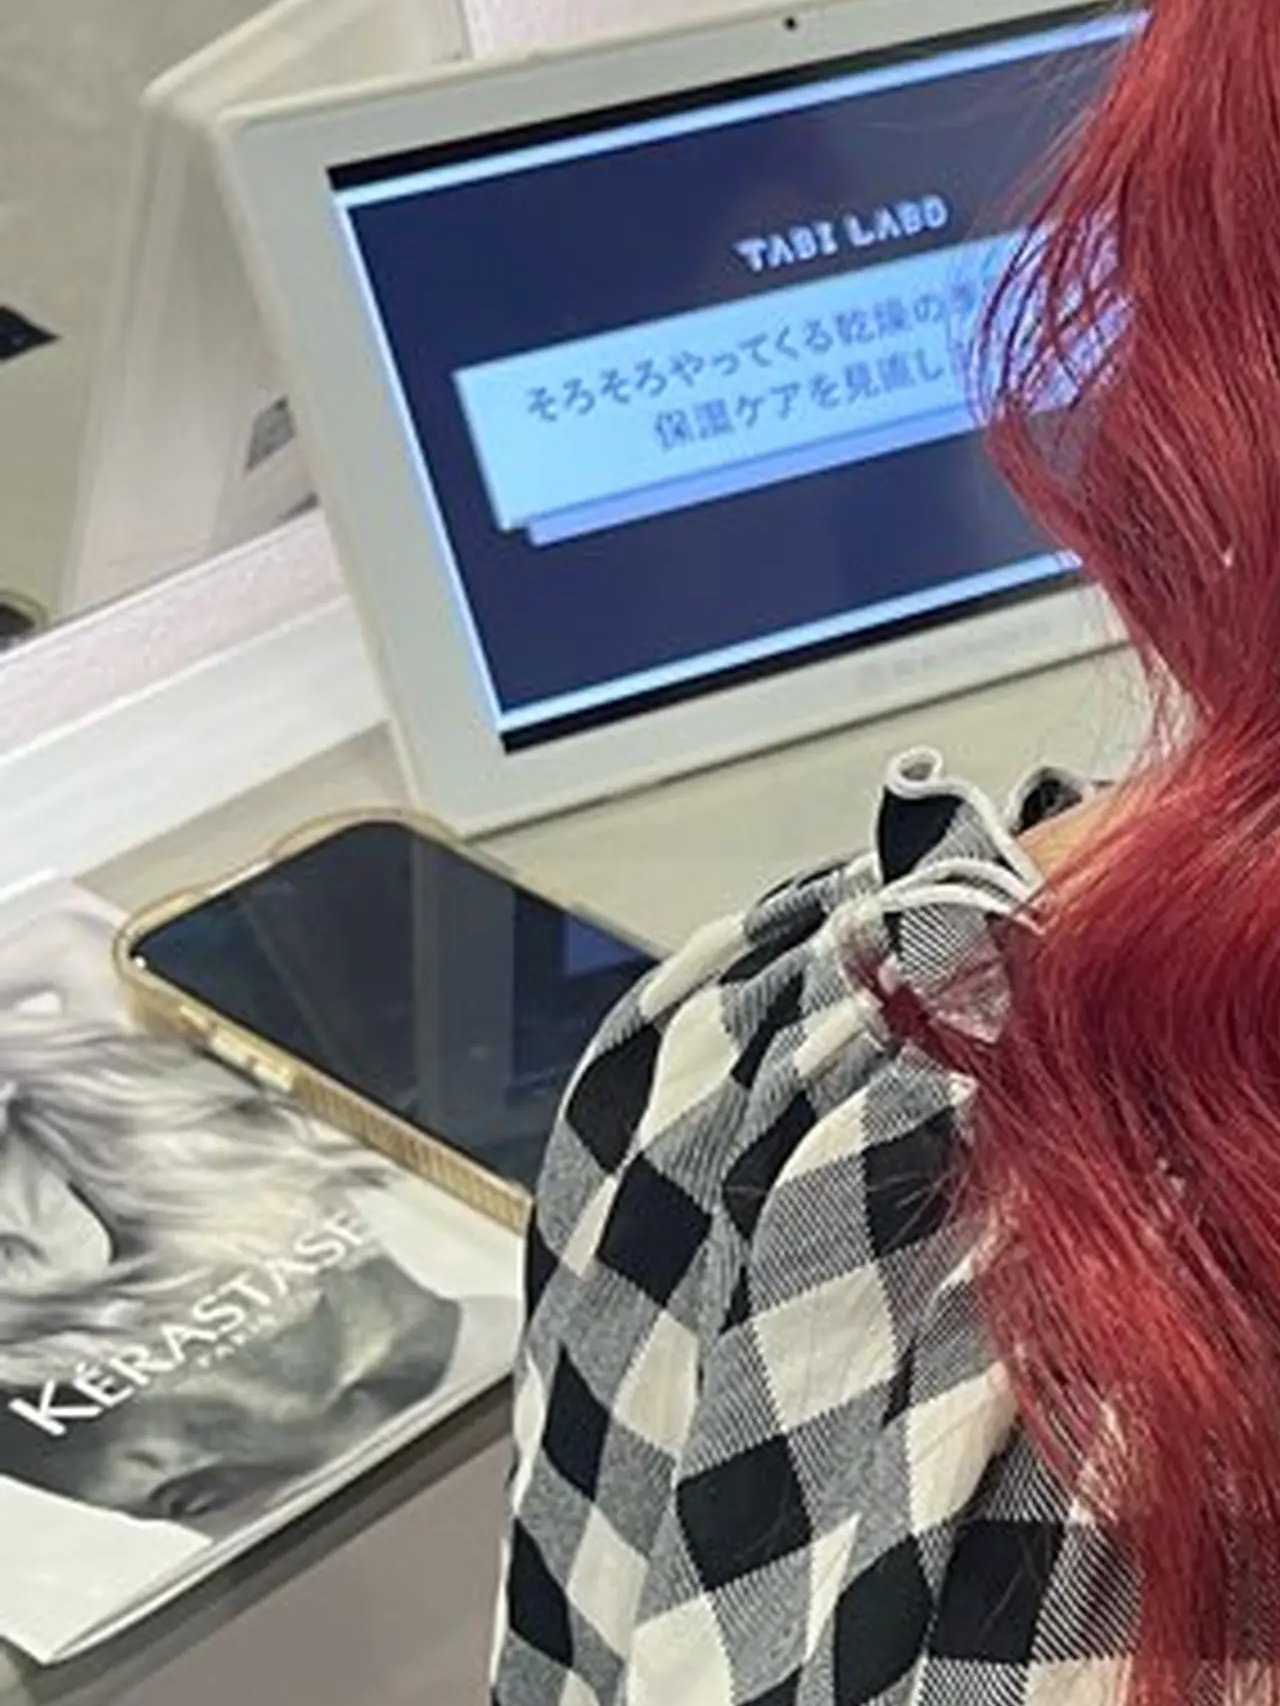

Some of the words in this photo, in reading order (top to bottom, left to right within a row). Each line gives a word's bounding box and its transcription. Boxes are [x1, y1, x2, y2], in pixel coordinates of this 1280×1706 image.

[735, 220, 839, 272] TABI
[847, 194, 949, 247] LABO
[655, 343, 968, 453] 保湿ケアを見直し
